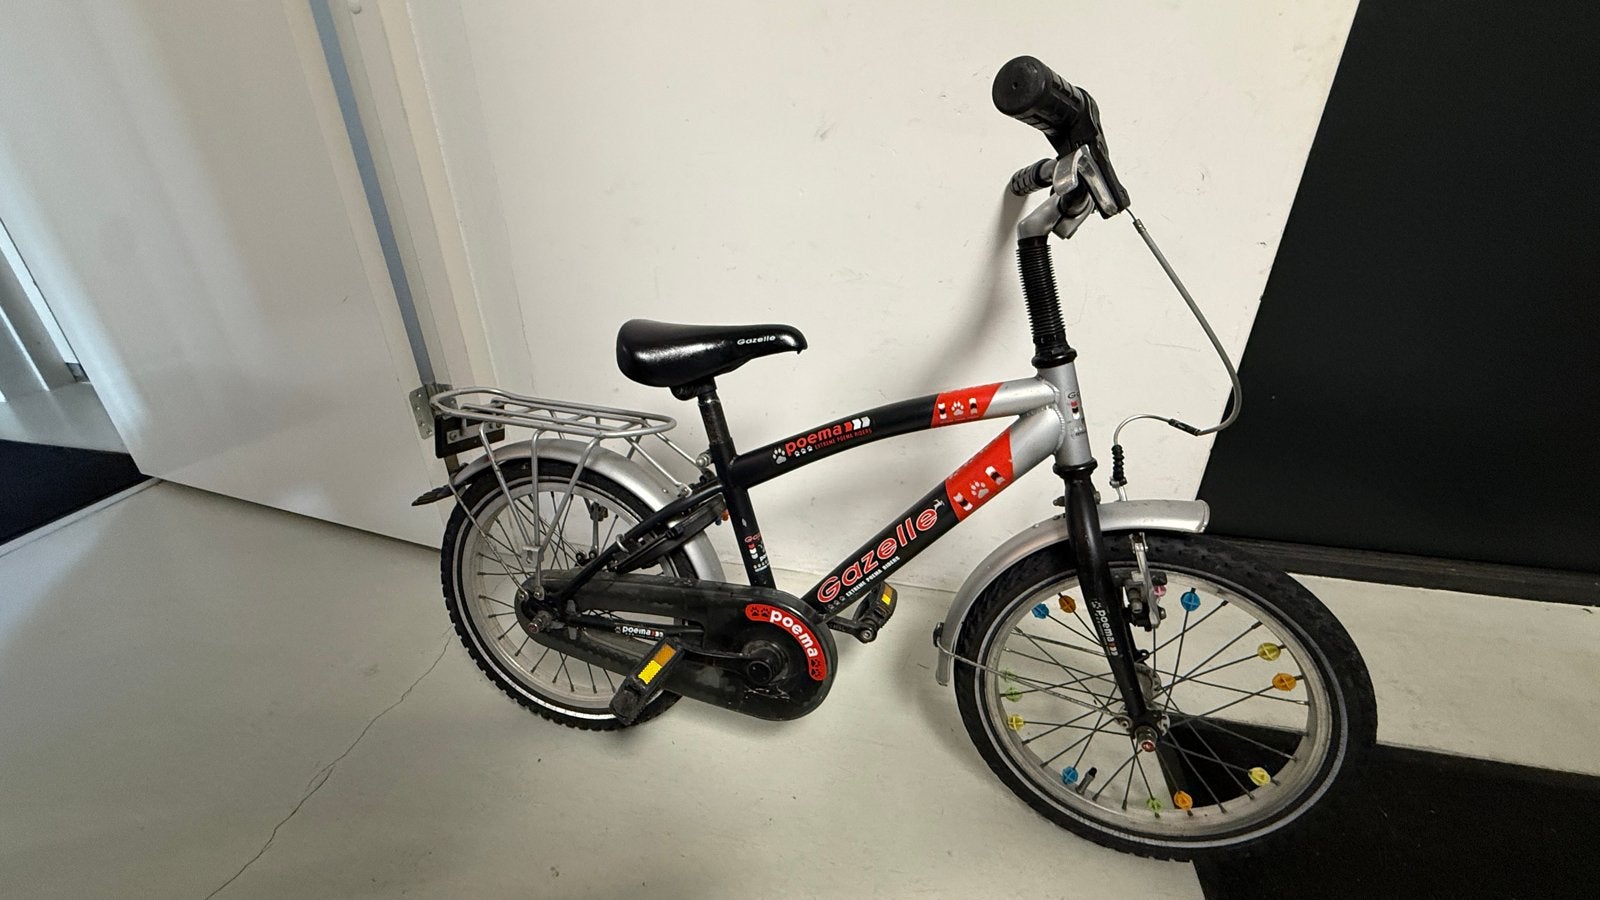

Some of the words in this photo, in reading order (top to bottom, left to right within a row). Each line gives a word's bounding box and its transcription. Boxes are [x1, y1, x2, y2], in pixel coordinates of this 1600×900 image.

[737, 335, 776, 346] Gazelle
[785, 424, 842, 457] poema
[817, 508, 938, 603] Gazelle
[622, 626, 651, 636] poema
[769, 610, 818, 658] poema
[1096, 609, 1115, 643] poema
